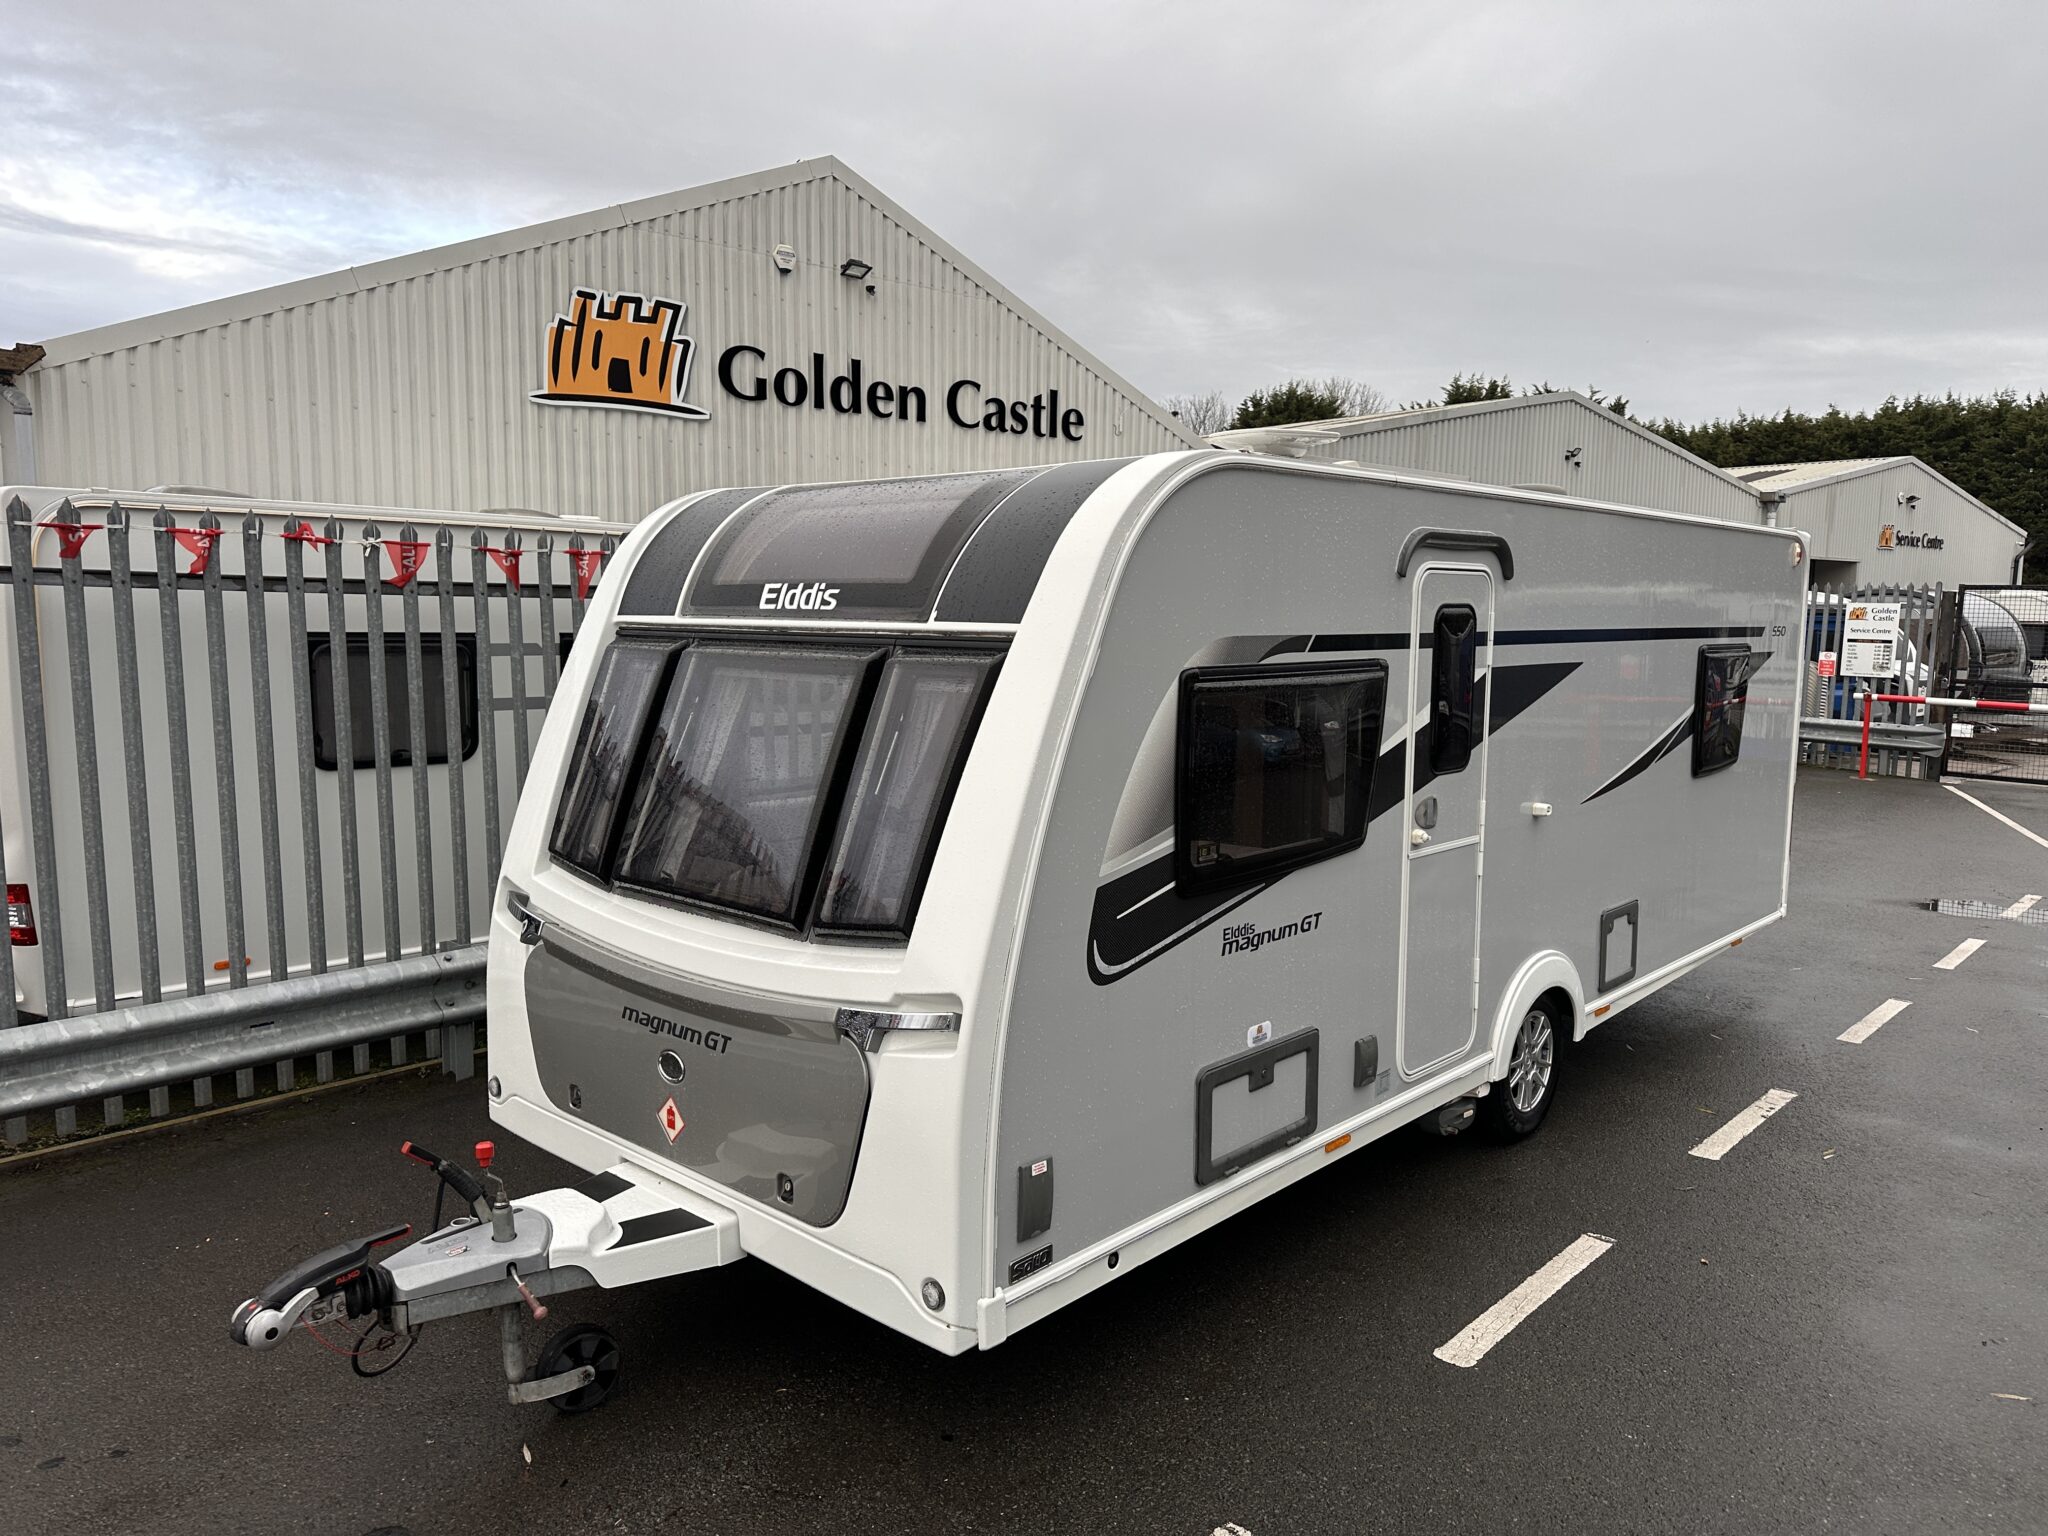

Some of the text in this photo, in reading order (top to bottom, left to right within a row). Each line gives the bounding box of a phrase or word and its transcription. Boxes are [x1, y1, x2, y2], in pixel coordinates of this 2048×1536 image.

[717, 344, 1085, 442] Golden Castle
[1895, 530, 1944, 550] Service Centre
[759, 582, 841, 611] Elddis
[1871, 607, 1898, 615] Golden
[1872, 614, 1895, 622] Castle
[1772, 625, 1787, 637] 550
[1871, 627, 1892, 635] Centre
[1223, 922, 1256, 941] Elddis
